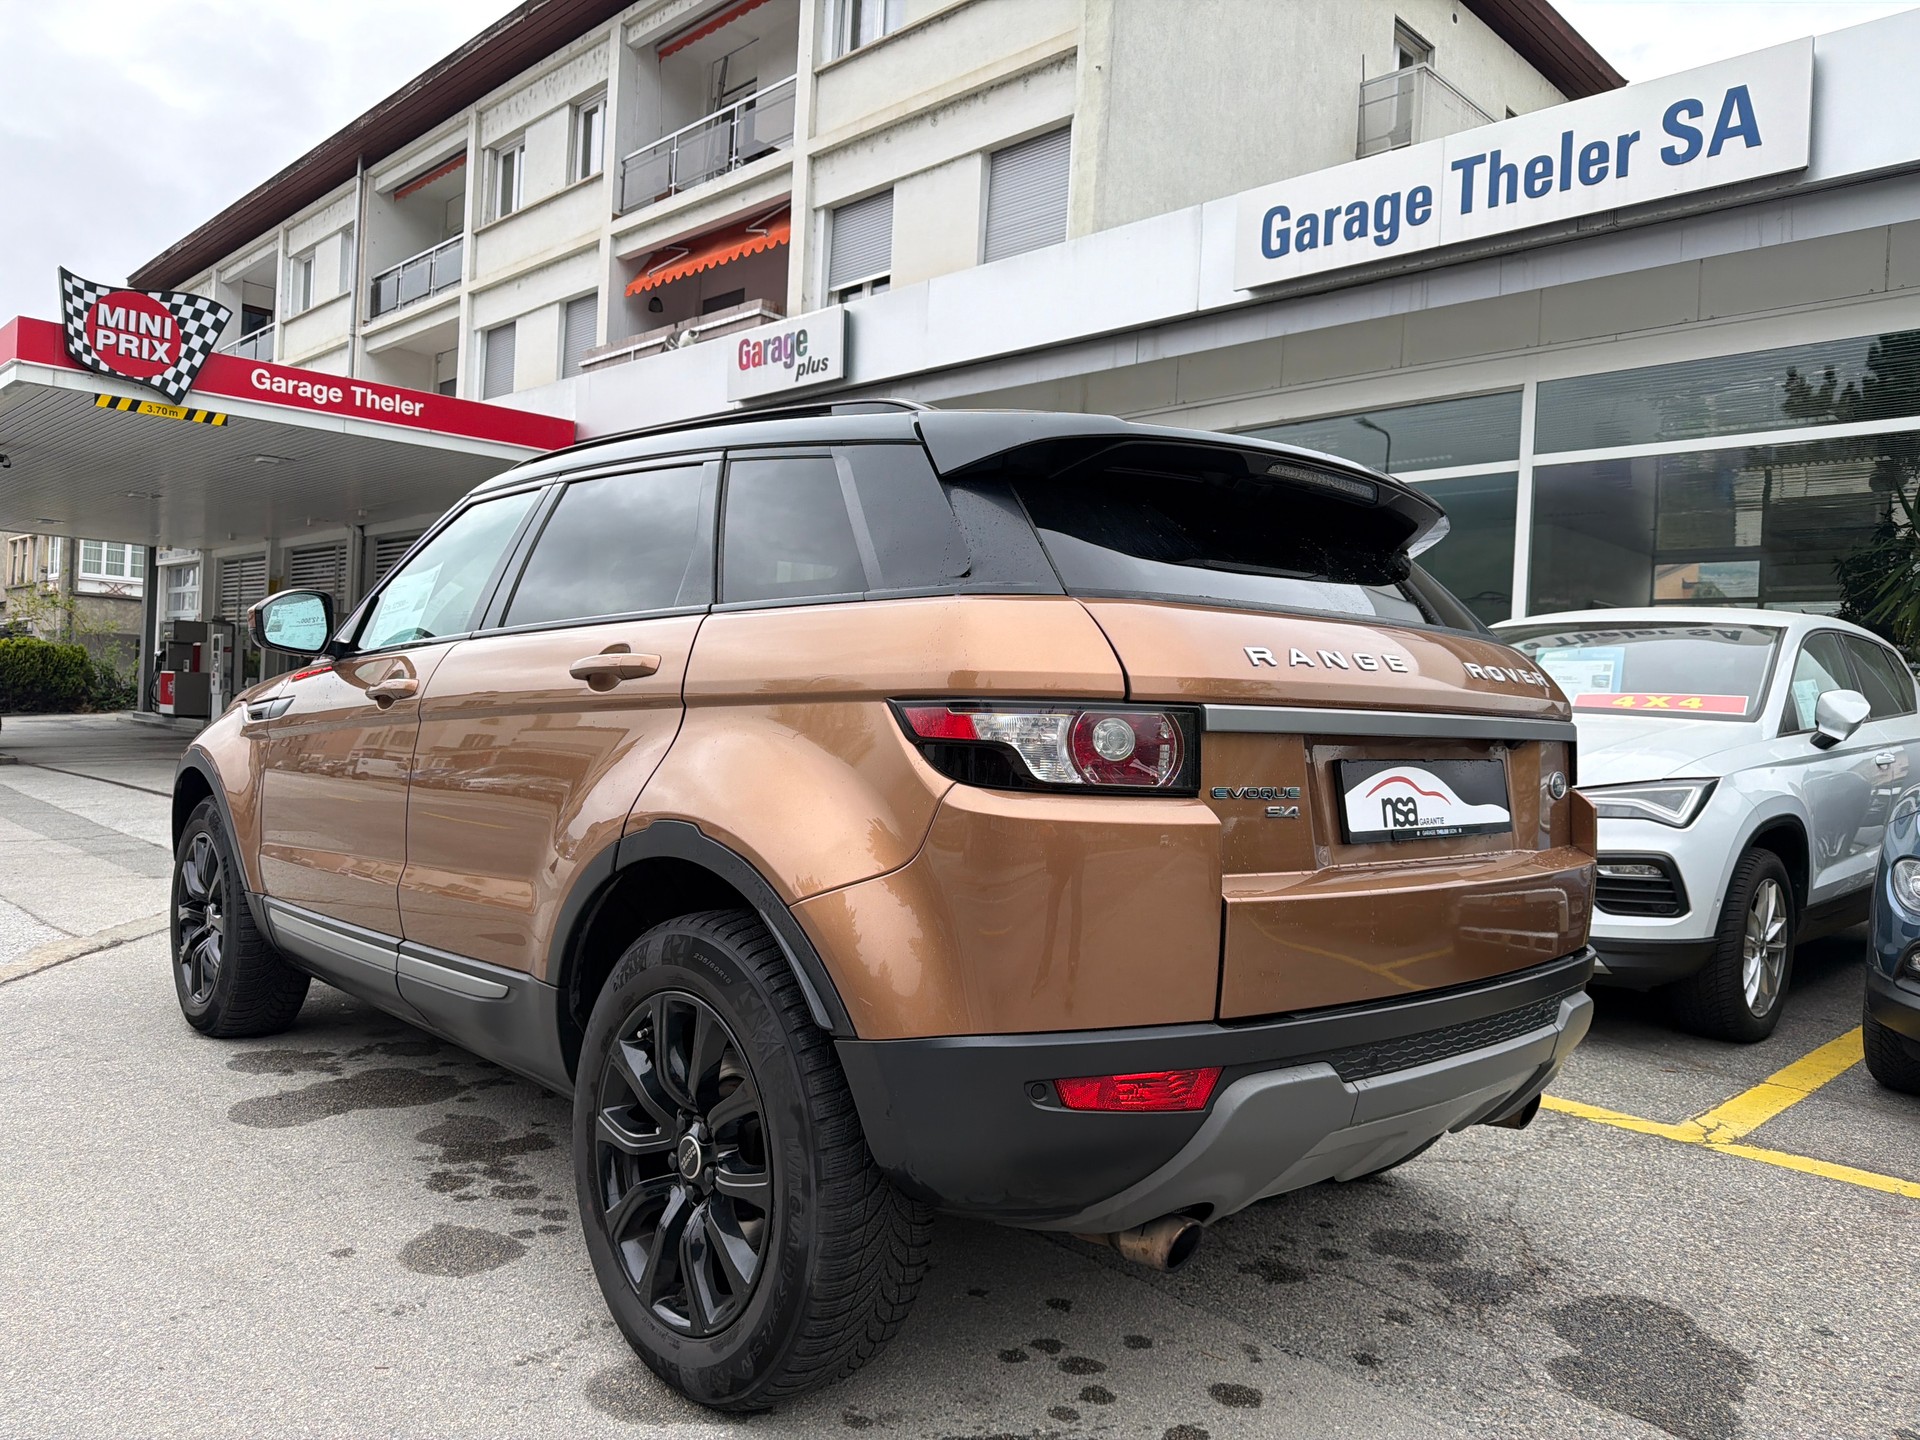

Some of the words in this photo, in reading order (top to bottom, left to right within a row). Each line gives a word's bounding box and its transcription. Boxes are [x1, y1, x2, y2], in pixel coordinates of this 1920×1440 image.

[1260, 183, 1433, 260] Garage
[1450, 130, 1641, 215] Theler
[1660, 83, 1762, 167] SA
[97, 302, 172, 340] MINI
[95, 328, 172, 365] PRIX
[738, 329, 808, 371] Garage
[795, 355, 829, 382] plus
[251, 368, 343, 405] Garage
[350, 386, 425, 417] Theler
[1243, 646, 1409, 673] RANGE
[1462, 662, 1550, 688] ROVER
[1210, 786, 1301, 800] EVOQUE
[1381, 796, 1419, 828] nsa
[1419, 816, 1445, 826] GARANTIE
